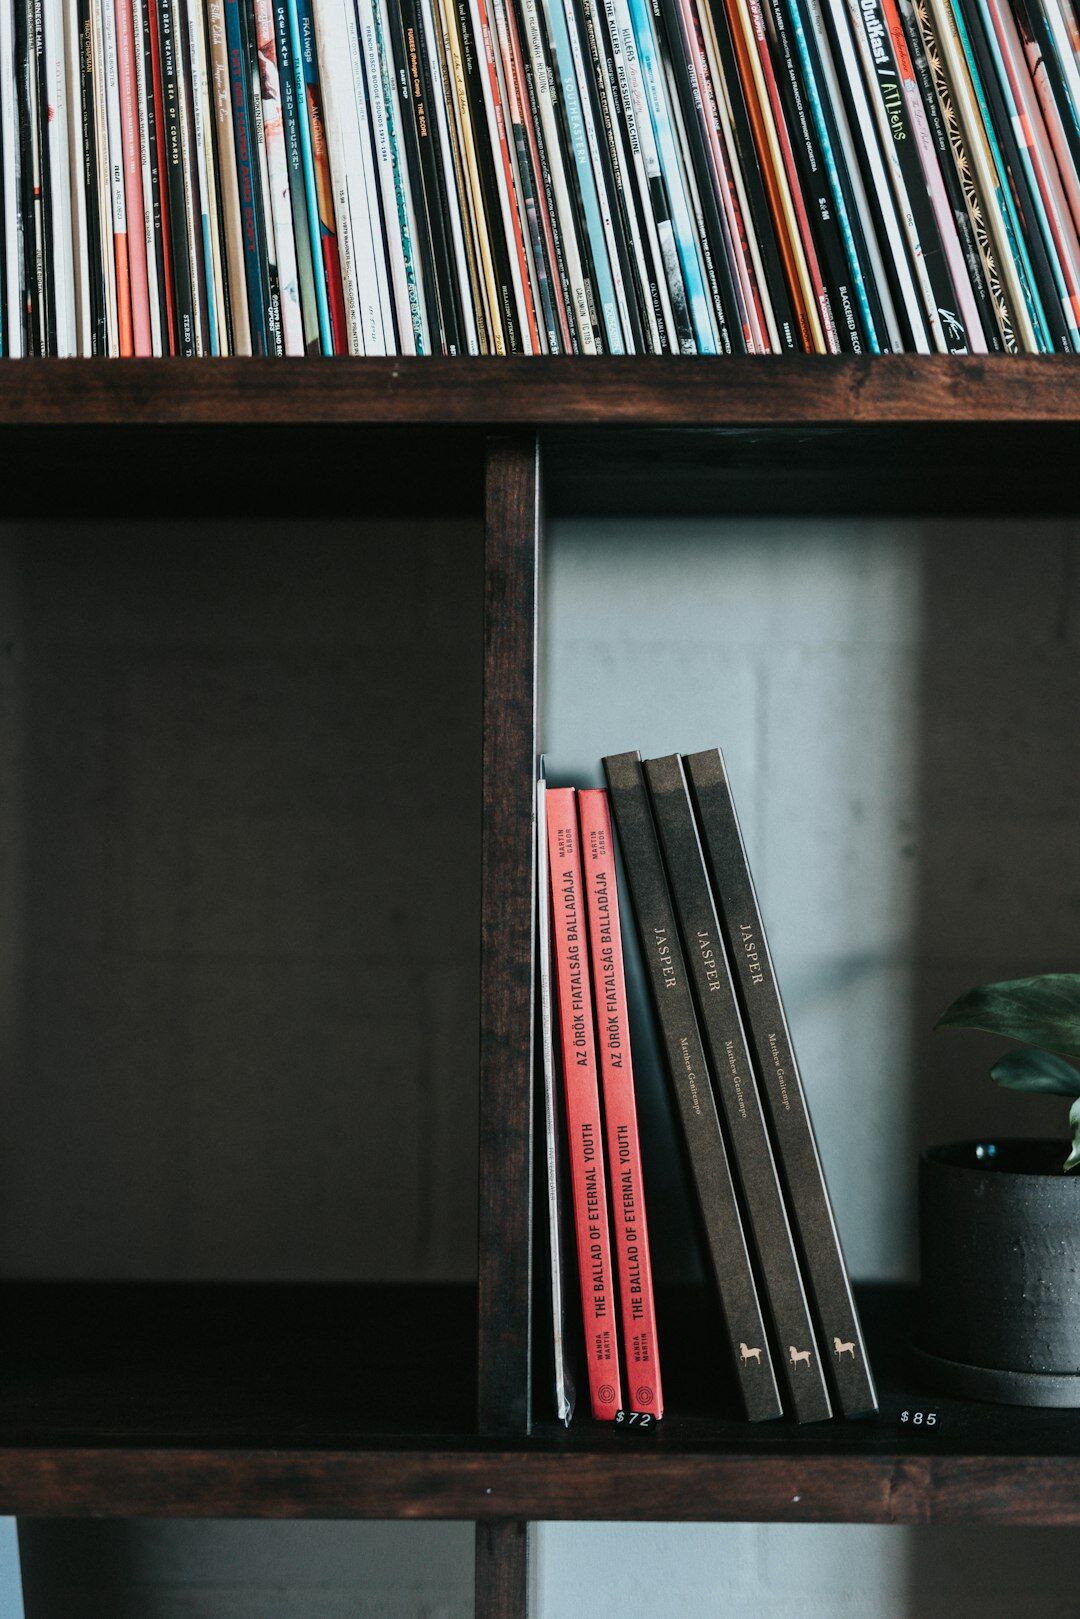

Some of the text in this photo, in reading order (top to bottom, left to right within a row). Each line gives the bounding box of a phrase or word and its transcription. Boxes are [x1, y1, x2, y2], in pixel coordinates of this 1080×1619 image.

[457, 2, 466, 15] And
[773, 8, 785, 30] KAMEN
[132, 14, 140, 37] COHEN
[301, 17, 315, 62] FKA twigs
[364, 26, 374, 51] FRENCH
[406, 28, 417, 51] FUGEES
[459, 22, 471, 45] smelled
[752, 14, 765, 40] PUPPETS
[857, 0, 891, 64] OutKast
[35, 35, 43, 56] HALL
[83, 20, 92, 72] TRACY CHAPMAN
[527, 17, 548, 93] HEMINGWAY READING
[620, 28, 636, 61] KILLERS
[778, 31, 792, 57] conducting
[276, 7, 296, 116] GAEL FAYE LUNDI
[368, 54, 377, 72] DISCO
[544, 65, 554, 85] JASON
[604, 58, 617, 84] Giorgos
[785, 58, 794, 68] THE
[787, 69, 797, 80] SAN
[162, 13, 179, 164] DEAD WEATHER SEA OF COWARDS
[370, 74, 380, 98] BOOGIE
[398, 69, 409, 98] BABY POP
[604, 1, 641, 154] THE KILLERS PRESSURE MACHINE
[685, 63, 703, 109] OTHER GIRLS
[416, 102, 425, 114] THE
[598, 91, 611, 128] CLEVELAND
[790, 81, 804, 110] FRANCISCO
[924, 92, 935, 103] The
[253, 93, 263, 143] BROKEN ENGLISH
[374, 101, 384, 127] SOUNDS
[563, 77, 588, 163] SOUTHEASTERN
[928, 105, 938, 116] Way
[931, 118, 942, 128] Out
[417, 115, 428, 136] SCORE
[797, 111, 811, 140] SYMPHONY
[804, 141, 818, 172] ORCHESTRA
[937, 137, 948, 150] Easy
[112, 165, 120, 182] RCA
[816, 197, 831, 220] S&M
[342, 235, 351, 260] WARNER
[347, 280, 356, 308] RECORDS
[838, 286, 856, 329] BLACKENED
[182, 314, 192, 342] STEREO
[273, 322, 283, 344] ISLAND
[351, 322, 360, 347] PRINTED
[547, 330, 558, 345] EPIC
[655, 318, 668, 347] MRI-204
[590, 831, 599, 860] MARTIN
[561, 871, 588, 1066] AZ ÖRÖK FIATALSÁG BALLADÁJA
[654, 928, 677, 988] JASPER
[697, 932, 721, 992] JASPER
[739, 925, 764, 984] JASPER
[594, 872, 623, 1068] AZ ÖRÖK FIATALSÁG BALLADÁJA
[680, 1037, 701, 1115] Matthew Genitempo
[725, 1041, 747, 1118] Matthew Genitempo
[768, 1033, 791, 1110] Matthew Genitempo
[581, 1124, 607, 1318] THE BALLAD OF ETERNAL YOUTH
[616, 1126, 644, 1320] THE BALLAD OF ETERNAL YOUTH
[595, 1334, 603, 1360] WANDA
[603, 1332, 611, 1360] MARTIN
[632, 1336, 641, 1362] WANDA
[640, 1334, 649, 1362] MARTIN
[615, 1412, 651, 1426] $72
[900, 1411, 937, 1425] $85
